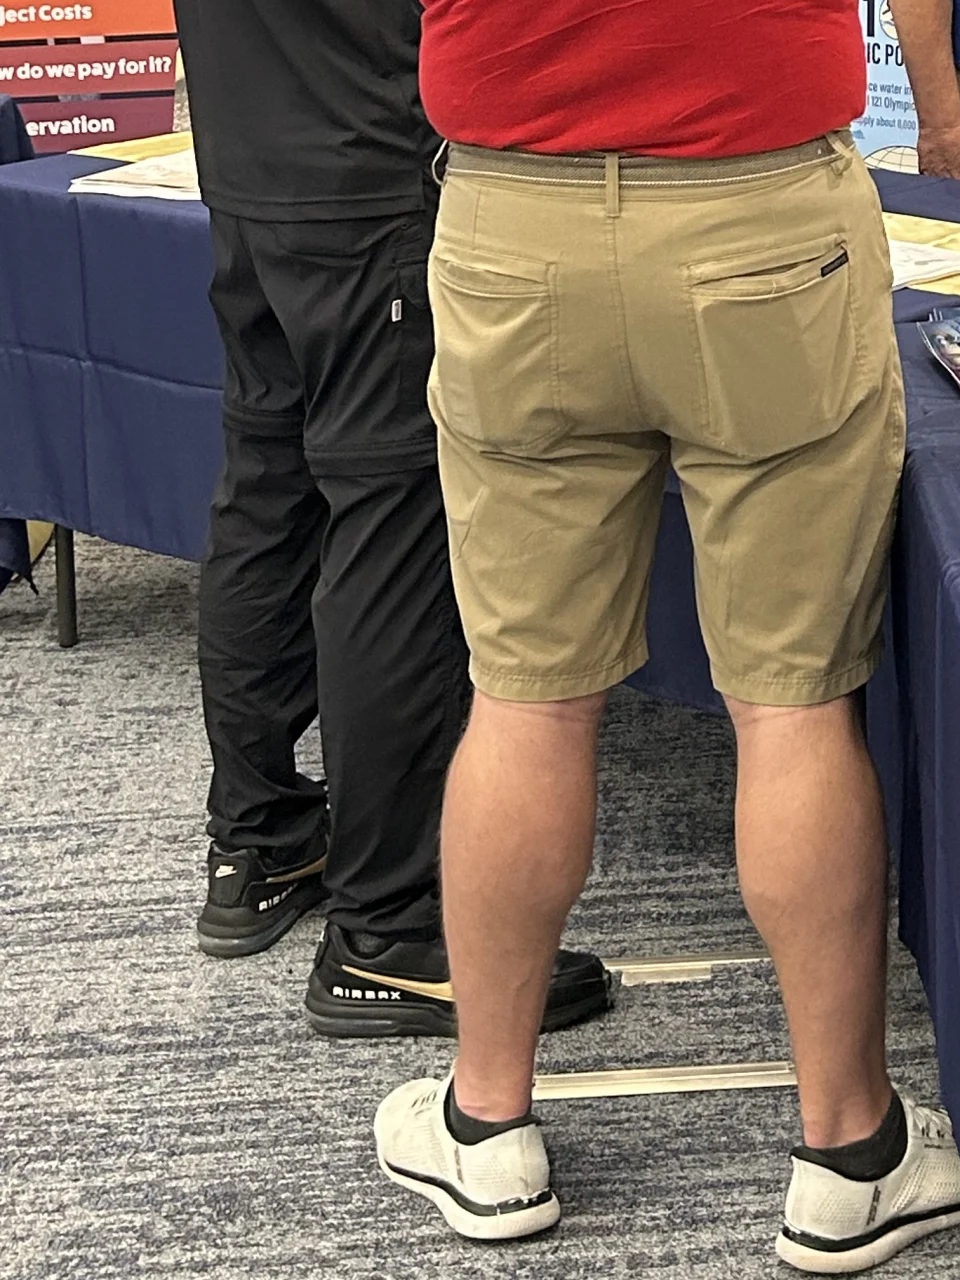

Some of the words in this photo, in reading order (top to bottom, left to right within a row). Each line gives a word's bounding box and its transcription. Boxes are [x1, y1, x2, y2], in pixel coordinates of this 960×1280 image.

[39, 4, 92, 21] Costs
[17, 62, 44, 80] do
[46, 62, 75, 78] we
[78, 62, 116, 81] pay
[118, 57, 147, 74] for
[149, 56, 172, 73] it?
[880, 84, 902, 95] water
